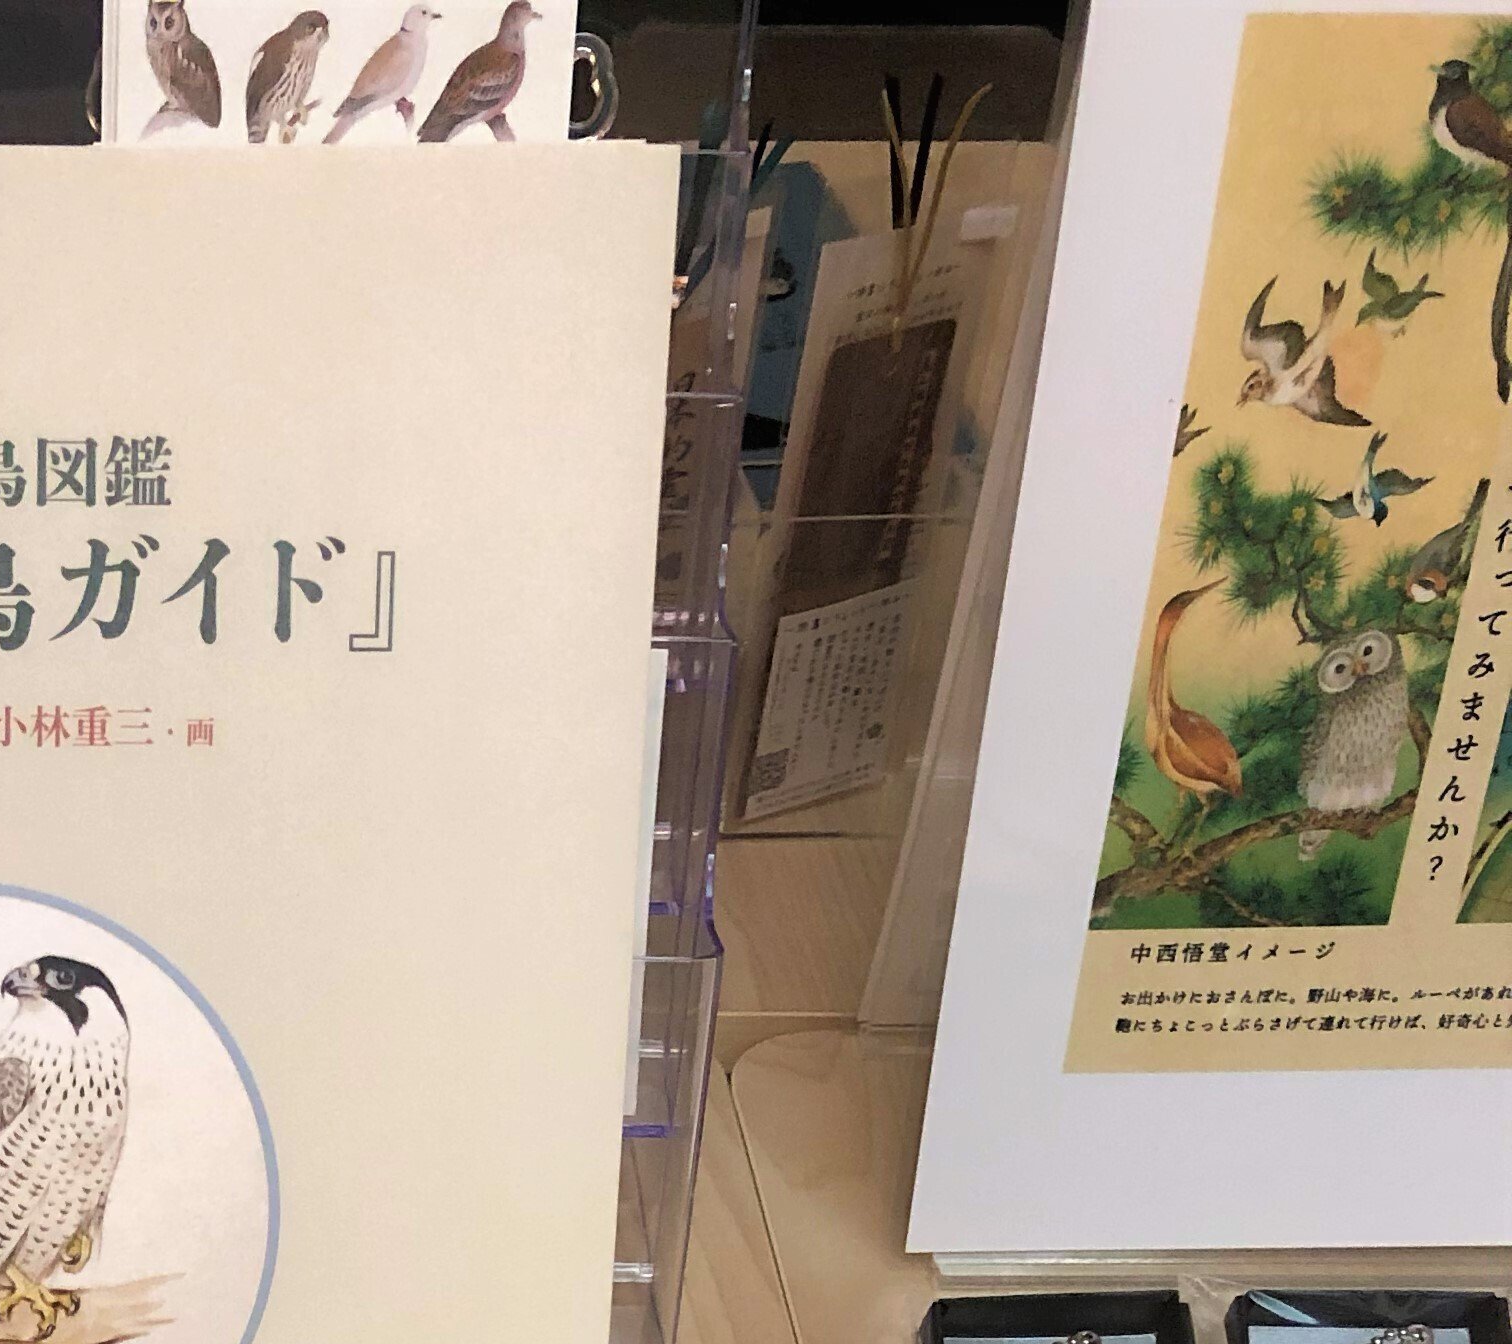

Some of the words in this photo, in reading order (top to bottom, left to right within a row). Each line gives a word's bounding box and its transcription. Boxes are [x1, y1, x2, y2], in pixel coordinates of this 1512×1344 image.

[1129, 939, 1338, 966] 中西悟堂イメージ
